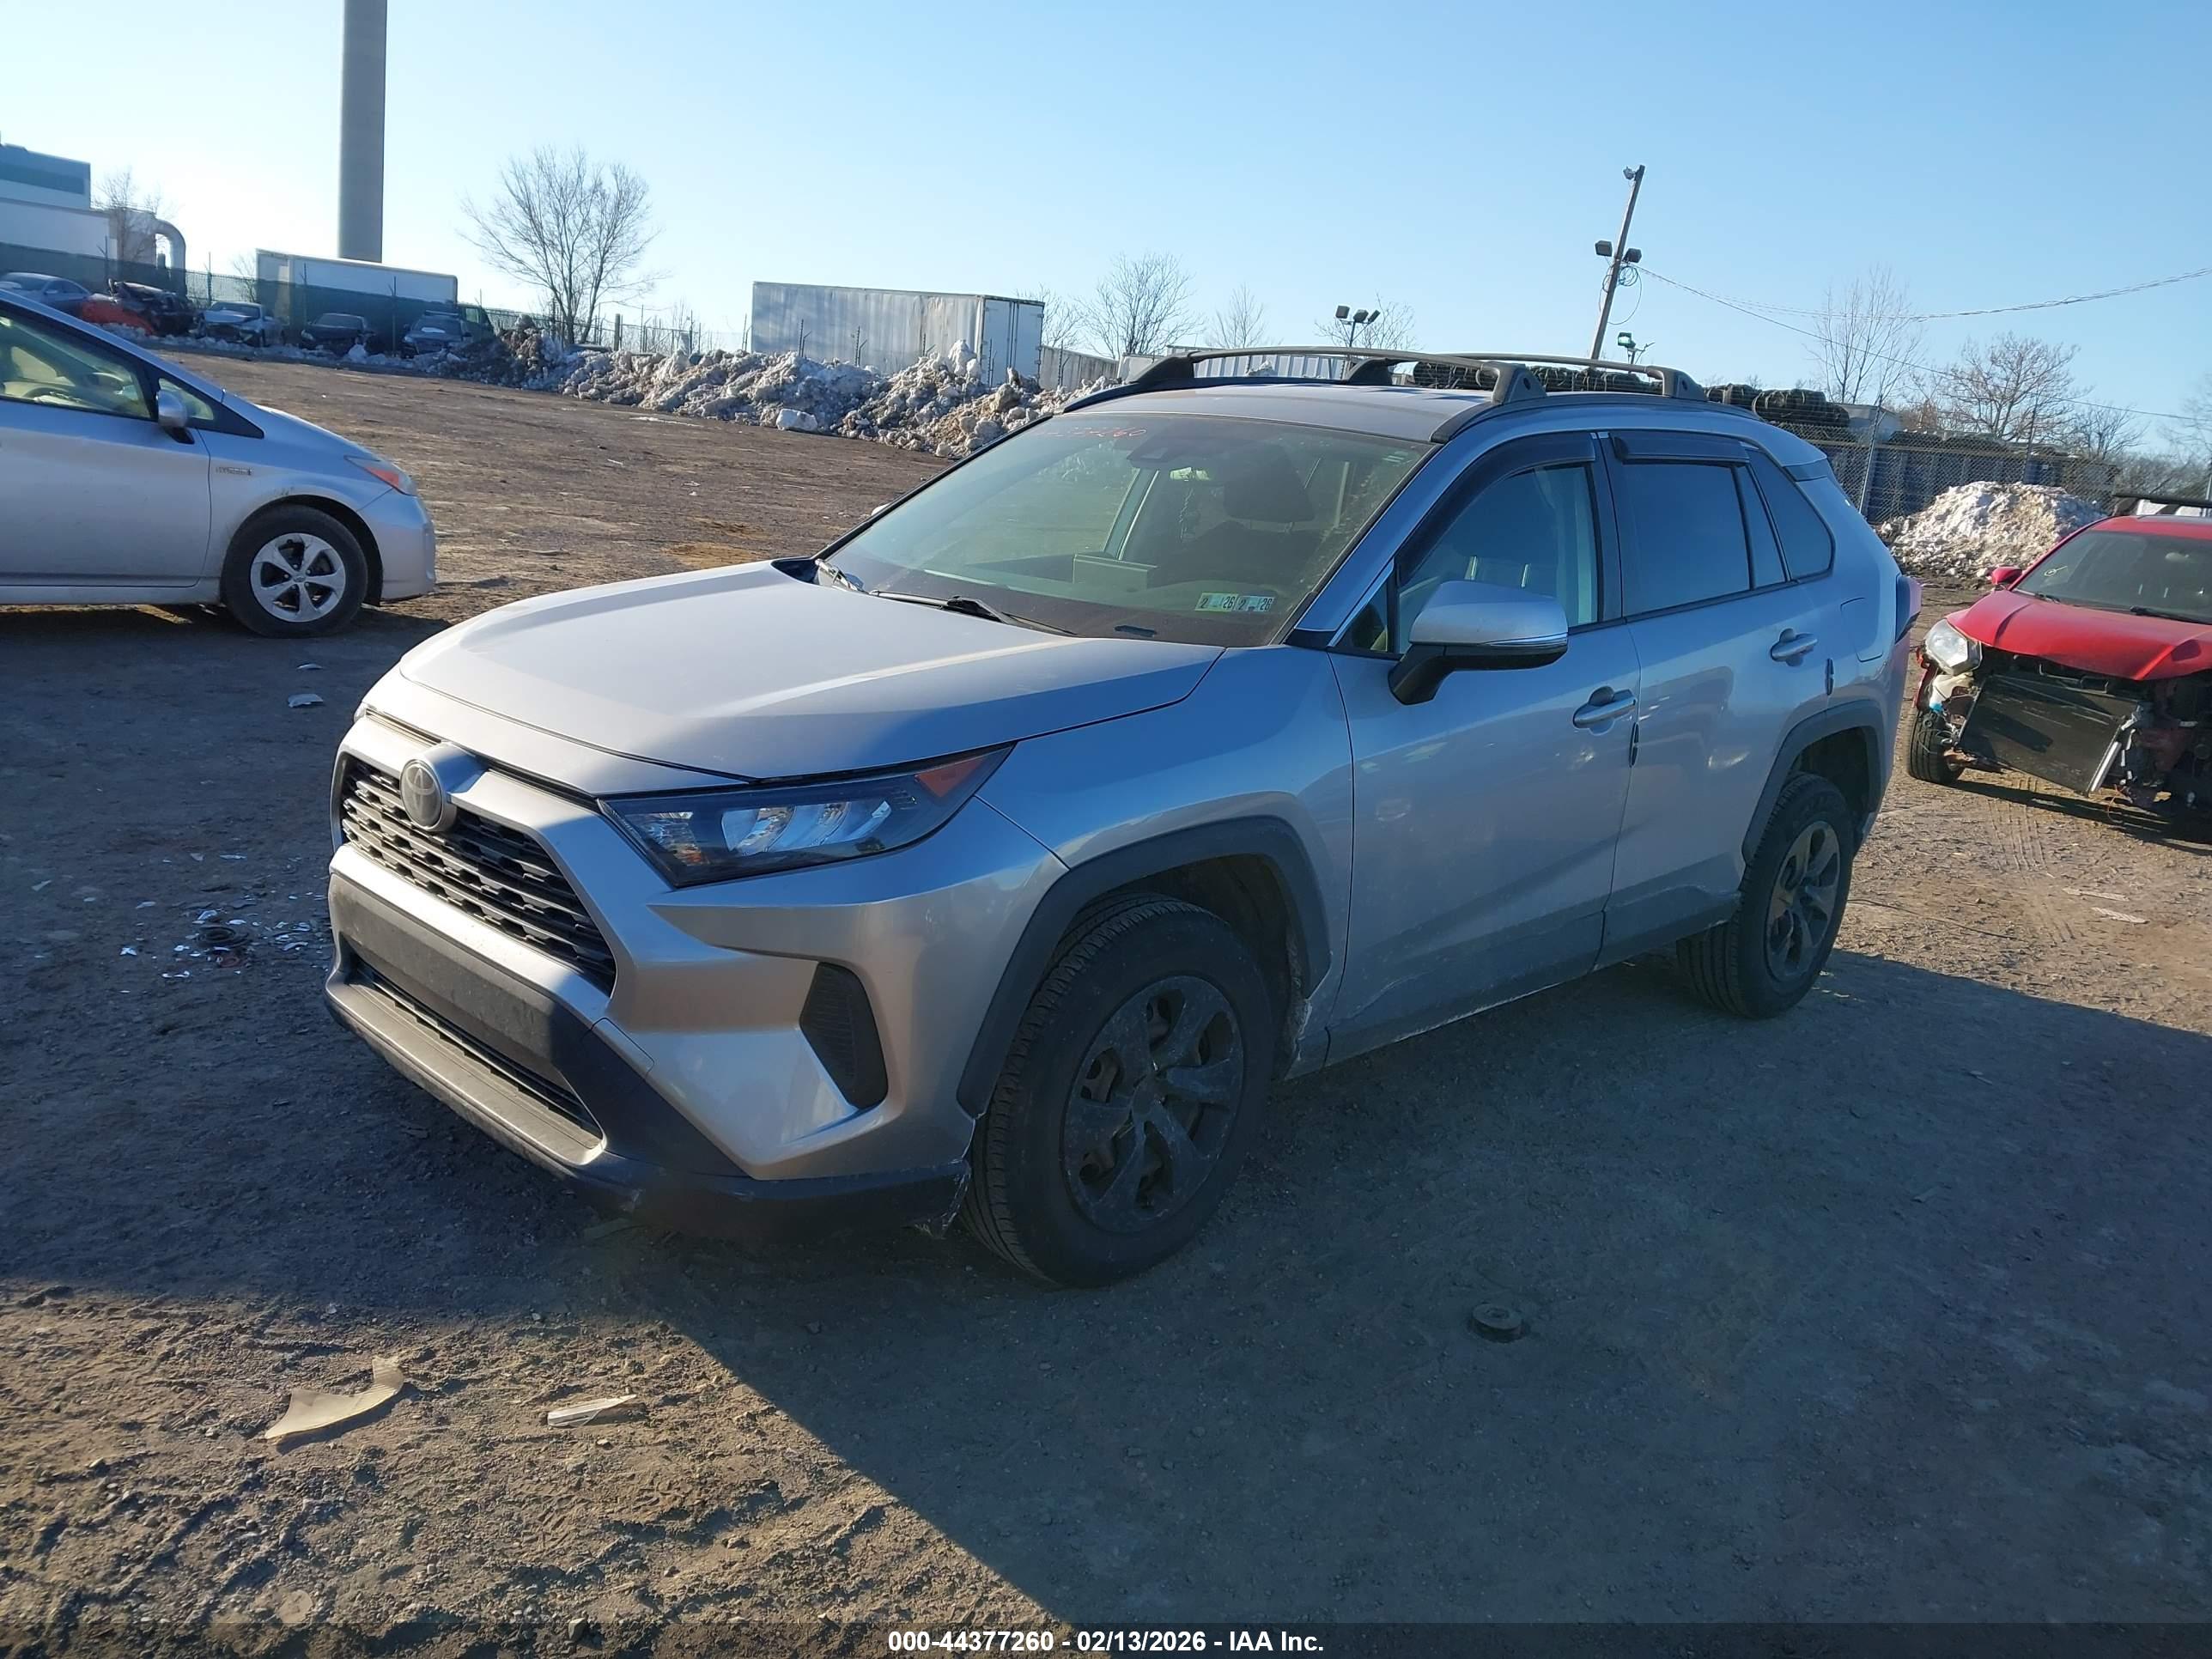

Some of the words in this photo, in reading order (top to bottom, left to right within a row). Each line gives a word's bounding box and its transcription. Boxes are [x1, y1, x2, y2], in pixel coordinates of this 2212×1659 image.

[1200, 598, 1209, 609] 2
[1223, 596, 1235, 609] 26
[1238, 599, 1246, 611] 2
